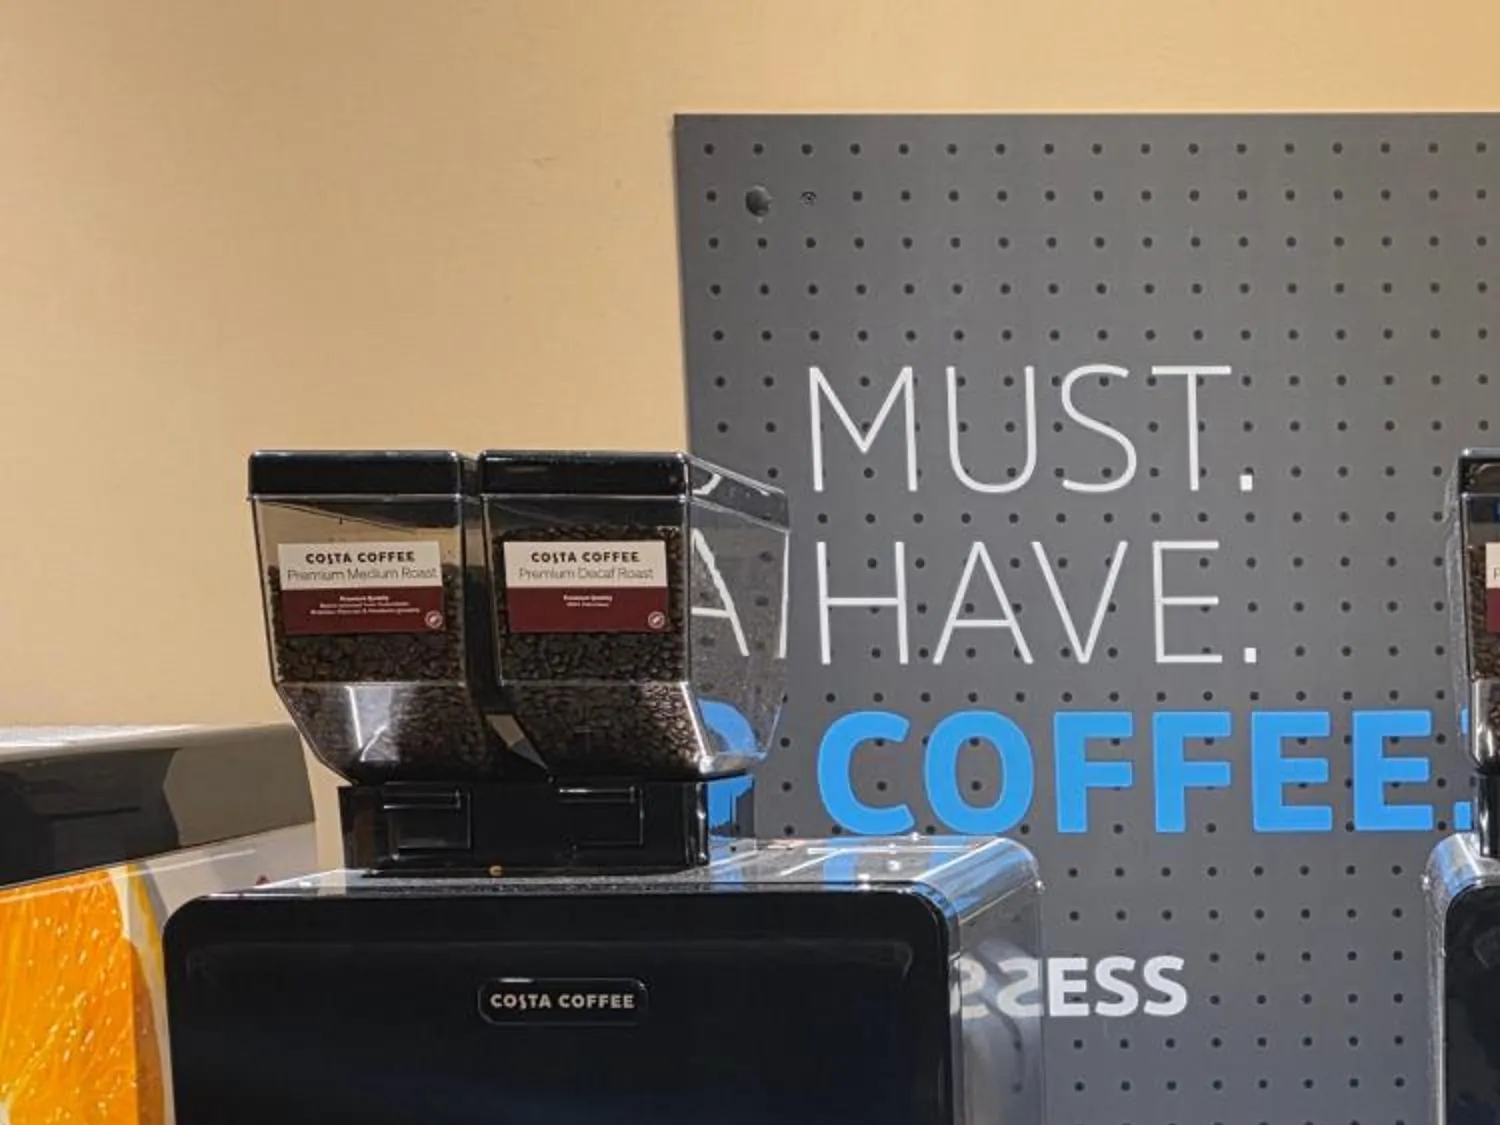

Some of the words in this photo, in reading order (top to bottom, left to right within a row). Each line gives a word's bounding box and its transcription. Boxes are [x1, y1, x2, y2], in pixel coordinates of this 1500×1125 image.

[808, 365, 1254, 493] MUST.
[305, 552, 352, 564] COSTA
[357, 551, 415, 563] COFFEE
[531, 551, 577, 563] COSTA
[582, 551, 640, 563] COFFEE
[287, 568, 345, 580] Premium
[348, 568, 399, 580] Medium
[402, 566, 438, 579] Roast
[519, 567, 575, 580] Premium
[578, 567, 615, 579] Decaf
[618, 567, 654, 579] Roast
[817, 541, 1258, 665] HAVE.
[1048, 955, 1188, 1018] ESS
[490, 993, 551, 1009] COSTA
[558, 993, 635, 1008] COFFEE
